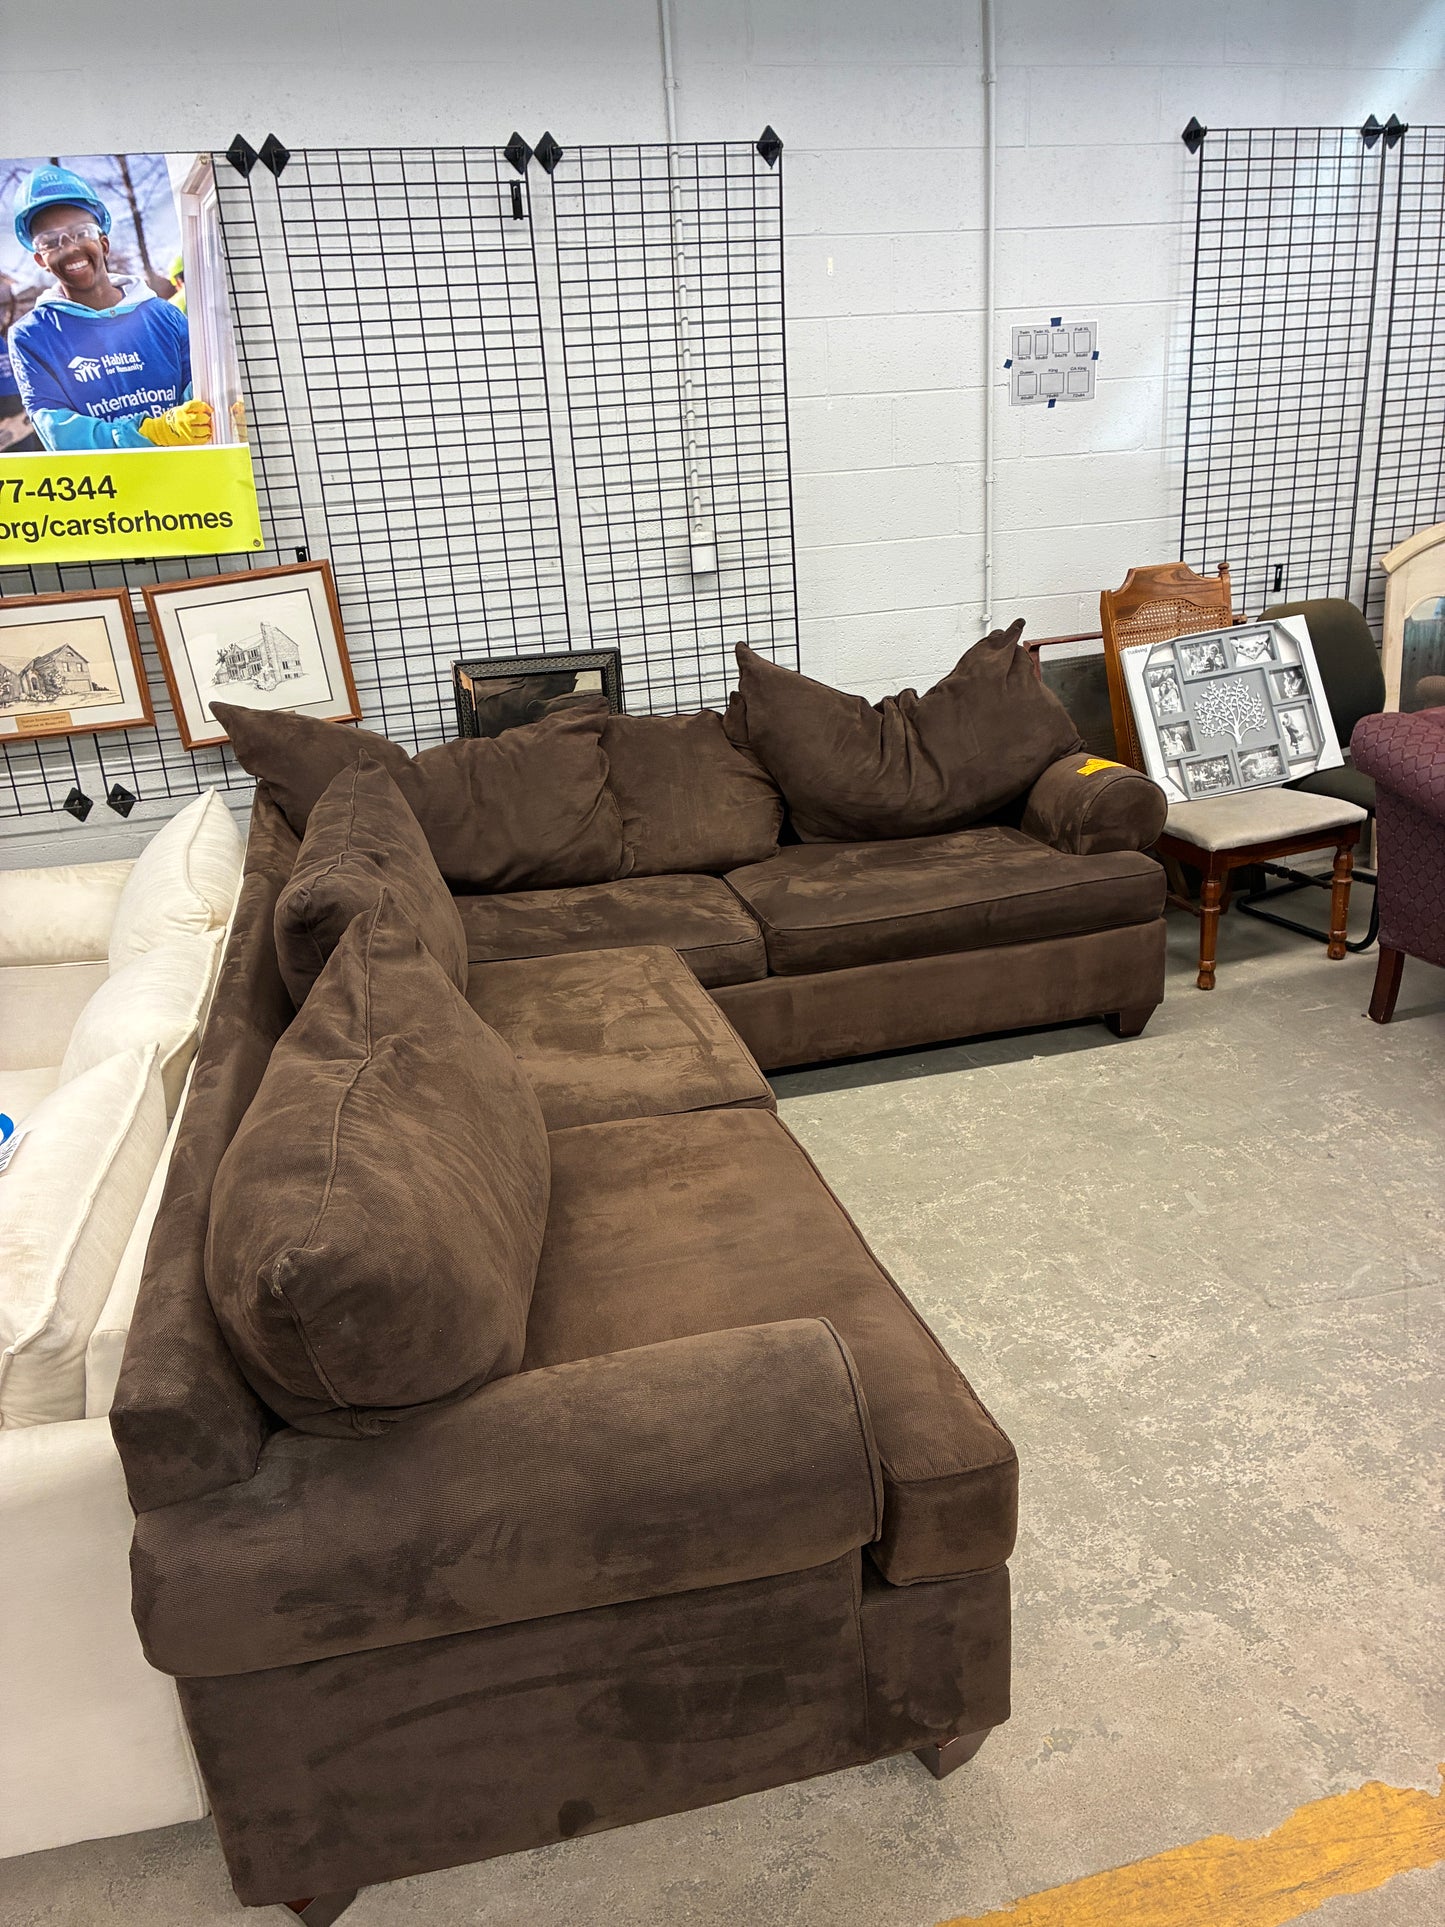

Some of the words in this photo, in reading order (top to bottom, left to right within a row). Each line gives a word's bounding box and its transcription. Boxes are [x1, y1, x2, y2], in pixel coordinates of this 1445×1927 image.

[100, 351, 142, 369] Habitat
[105, 367, 116, 376] for
[86, 384, 176, 417] International
[0, 474, 117, 503] 7-4344
[0, 509, 234, 544] org/carsforhomes
